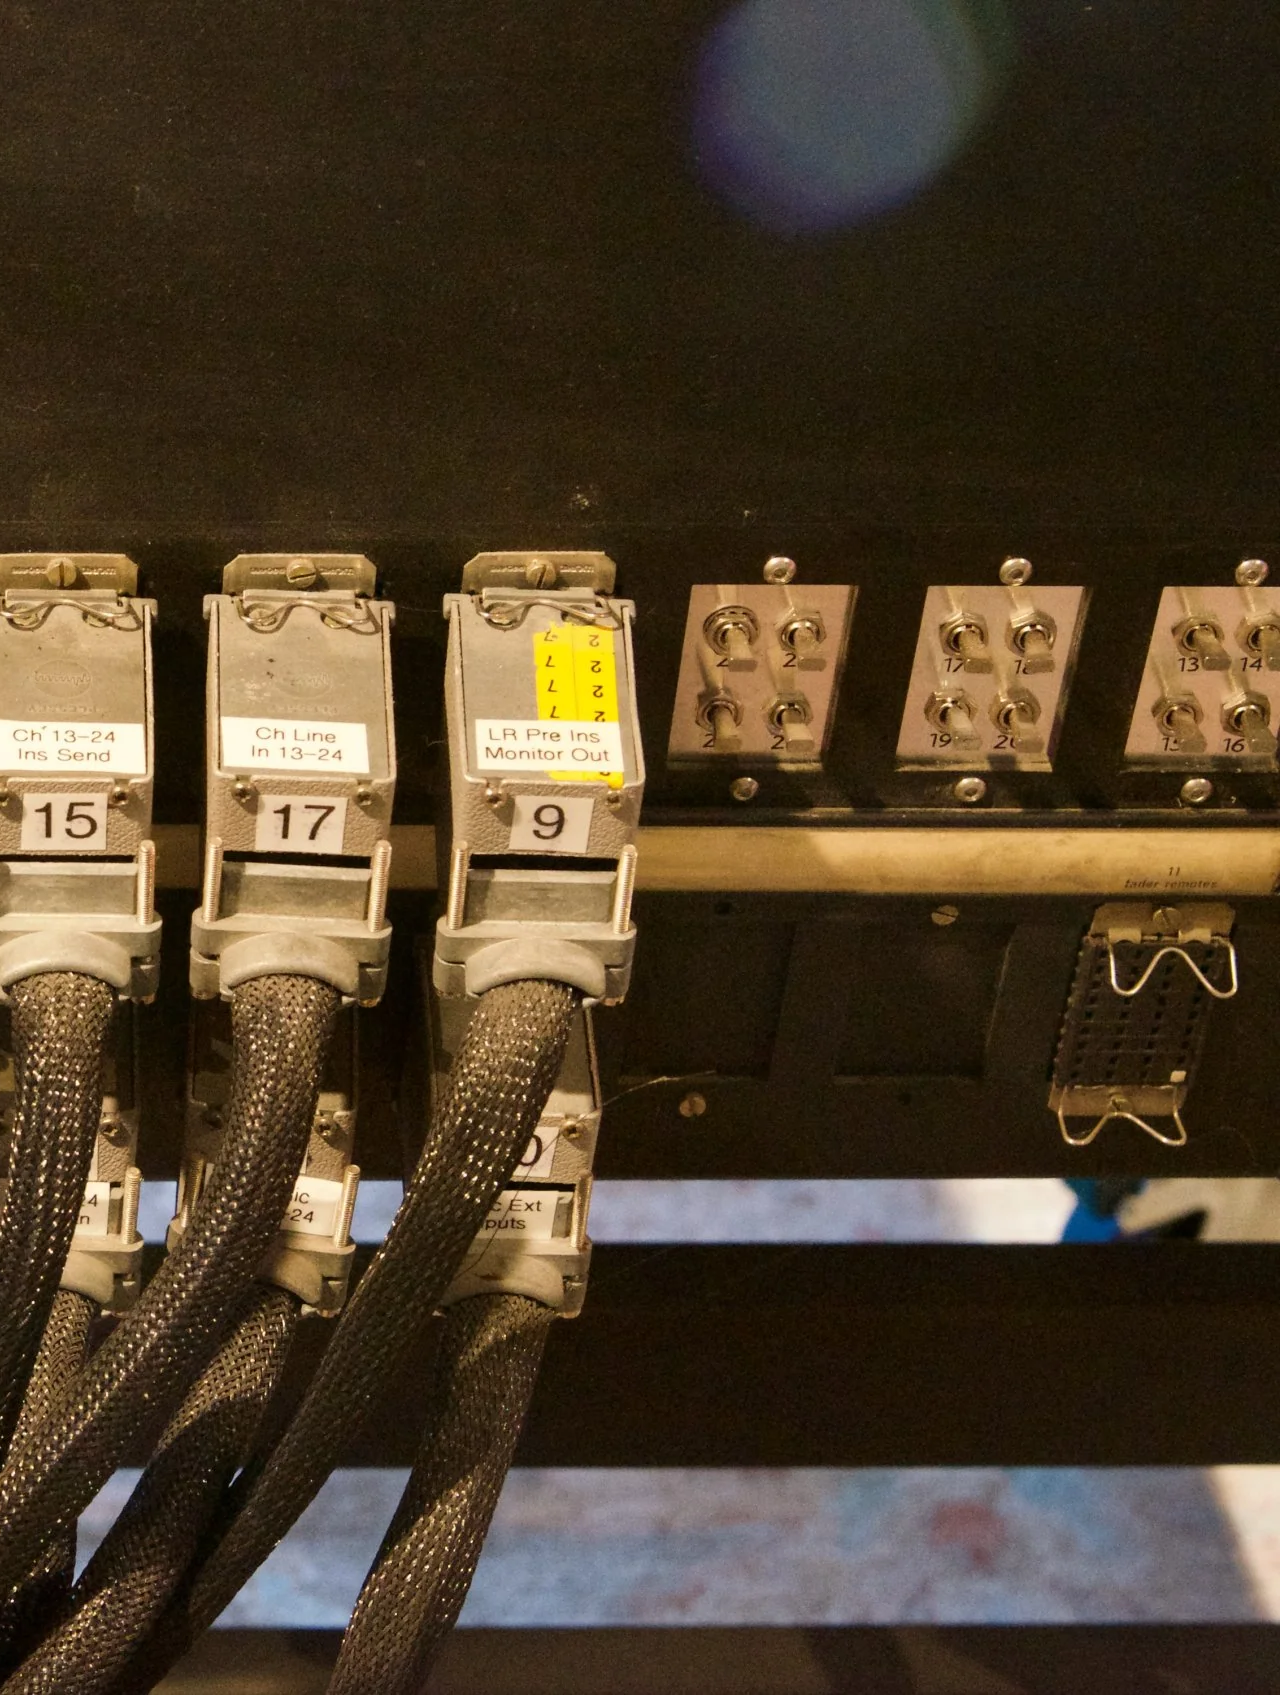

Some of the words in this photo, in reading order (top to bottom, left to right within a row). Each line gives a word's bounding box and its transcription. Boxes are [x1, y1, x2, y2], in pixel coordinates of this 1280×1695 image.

[588, 634, 600, 648] 2
[545, 655, 555, 668] 7
[590, 660, 602, 674] 2
[783, 652, 796, 667] 2
[1179, 656, 1199, 672] 13
[1240, 656, 1262, 672] 14
[547, 679, 558, 693] 7
[592, 685, 604, 699] 2
[549, 705, 560, 719] 7
[13, 729, 41, 741] Ch
[54, 730, 115, 743] 13-24
[256, 727, 284, 740] Ch
[294, 729, 336, 743] Line
[489, 728, 517, 740] LR
[527, 729, 560, 742] Pre
[571, 730, 600, 743] Ins
[703, 733, 713, 748] 2
[771, 734, 784, 750] 2
[931, 733, 952, 747] 19
[1224, 738, 1245, 752] 16
[19, 748, 47, 760] Ins
[58, 749, 110, 762] Send
[252, 745, 268, 757] In
[280, 747, 342, 761] 13-24
[486, 747, 563, 760] Monitor
[572, 748, 609, 761] Out
[35, 802, 97, 839] 15
[274, 804, 335, 840] 17
[533, 804, 565, 840] 9
[519, 1134, 543, 1166] 0
[293, 1187, 310, 1204] ic
[509, 1199, 541, 1212] Ext
[484, 1216, 525, 1230] puts
